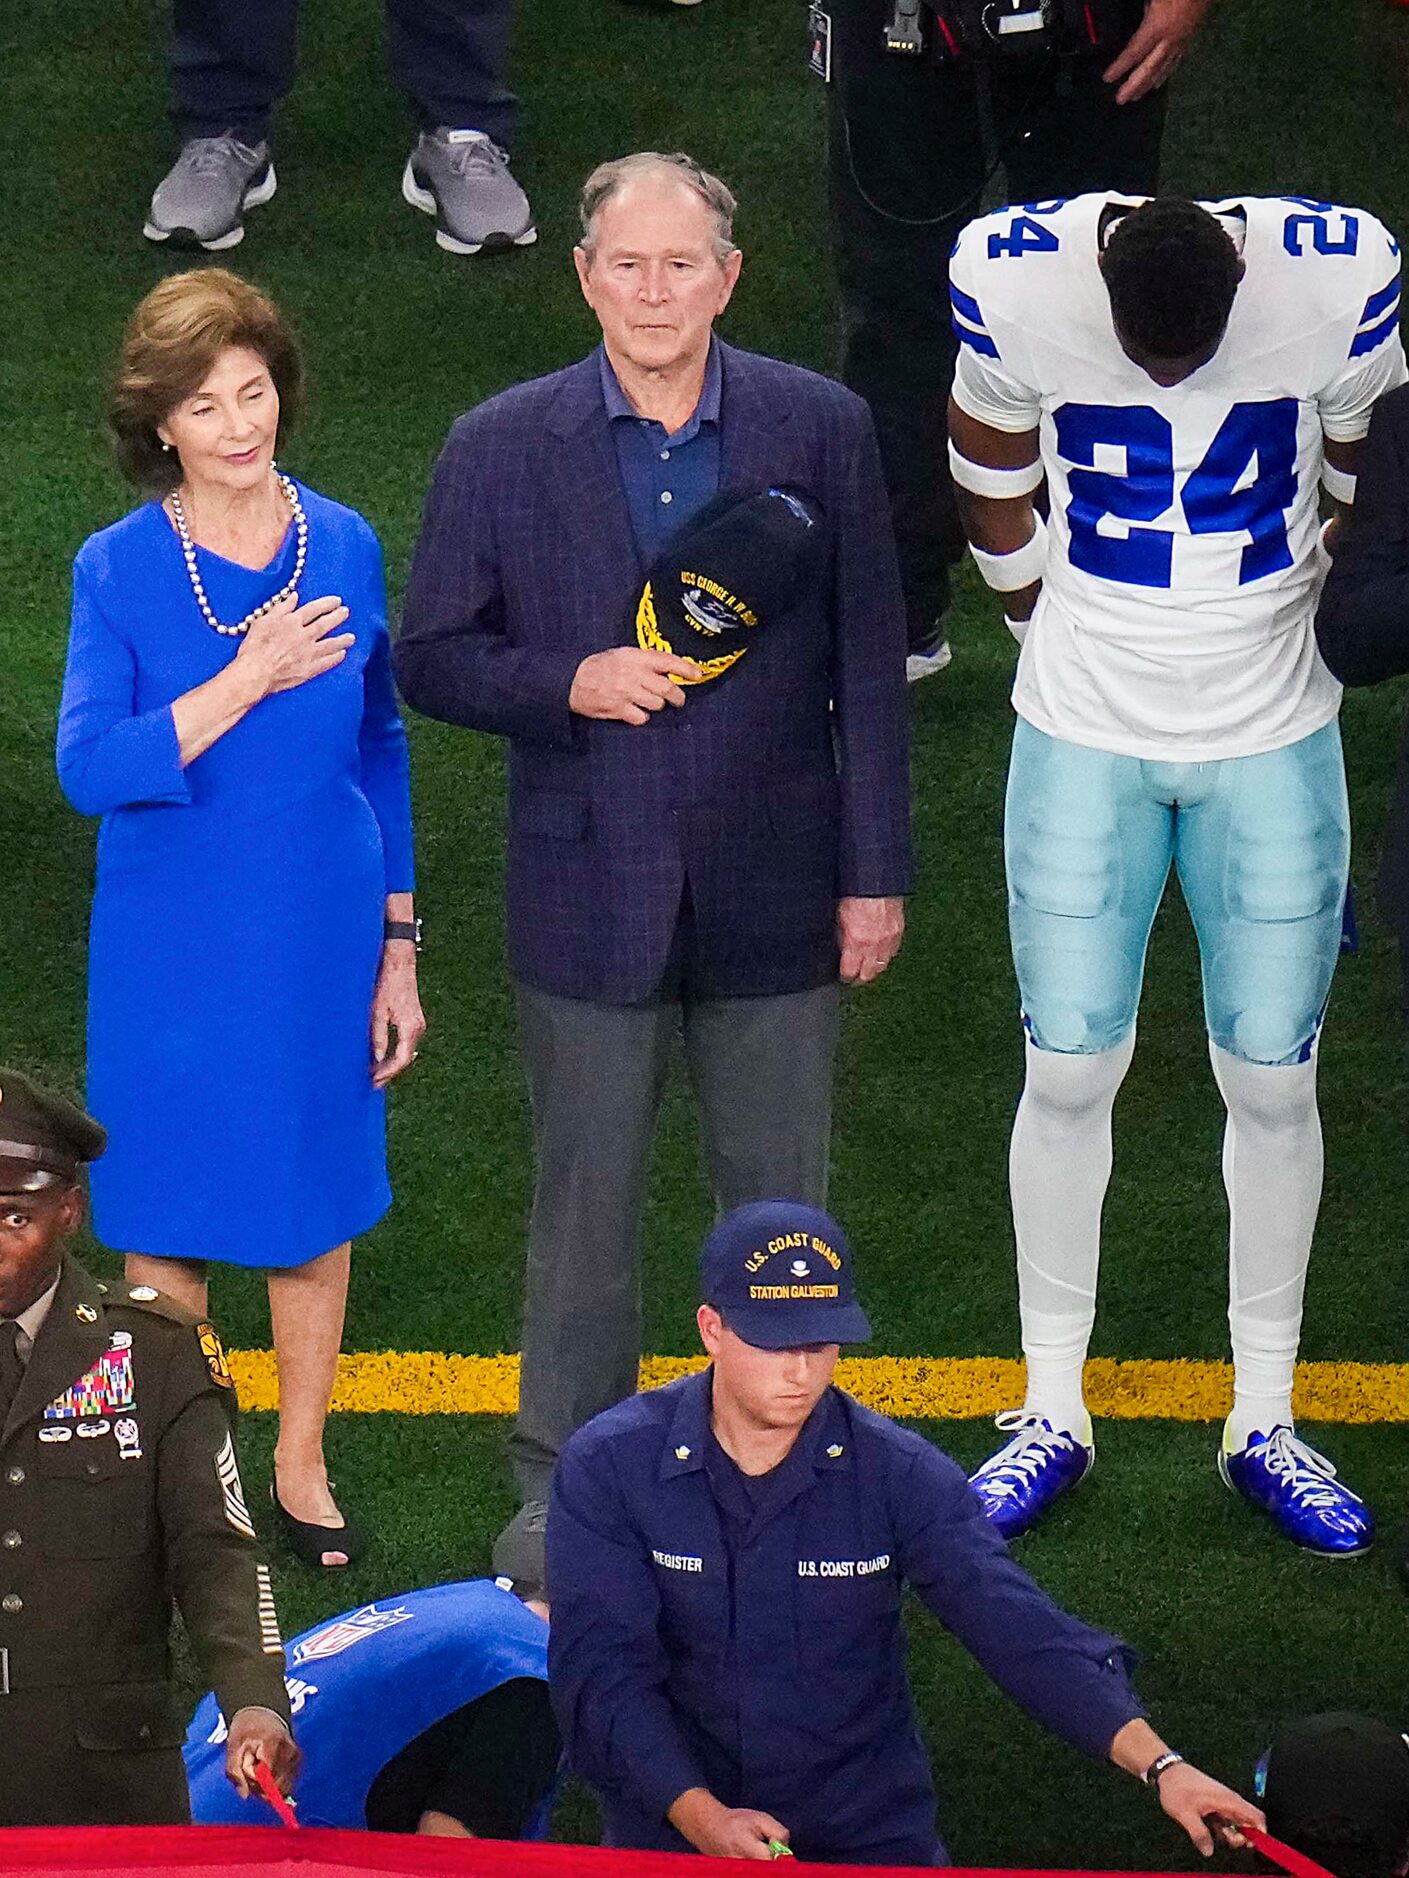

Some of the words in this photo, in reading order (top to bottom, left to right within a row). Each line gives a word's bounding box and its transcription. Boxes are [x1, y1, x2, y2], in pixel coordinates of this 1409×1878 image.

[1051, 397, 1300, 589] 24
[681, 571, 696, 586] USS
[697, 575, 729, 601] GEORGE
[744, 1251, 769, 1273] U.S.
[767, 1232, 809, 1254] COAST
[811, 1237, 843, 1271] GUARD
[749, 1285, 790, 1299] STATION
[790, 1284, 840, 1298] GALVESTON
[652, 1550, 703, 1573] REGISTER
[798, 1560, 819, 1577] U.S.
[819, 1561, 855, 1577] COAST
[855, 1554, 890, 1575] GUARD
